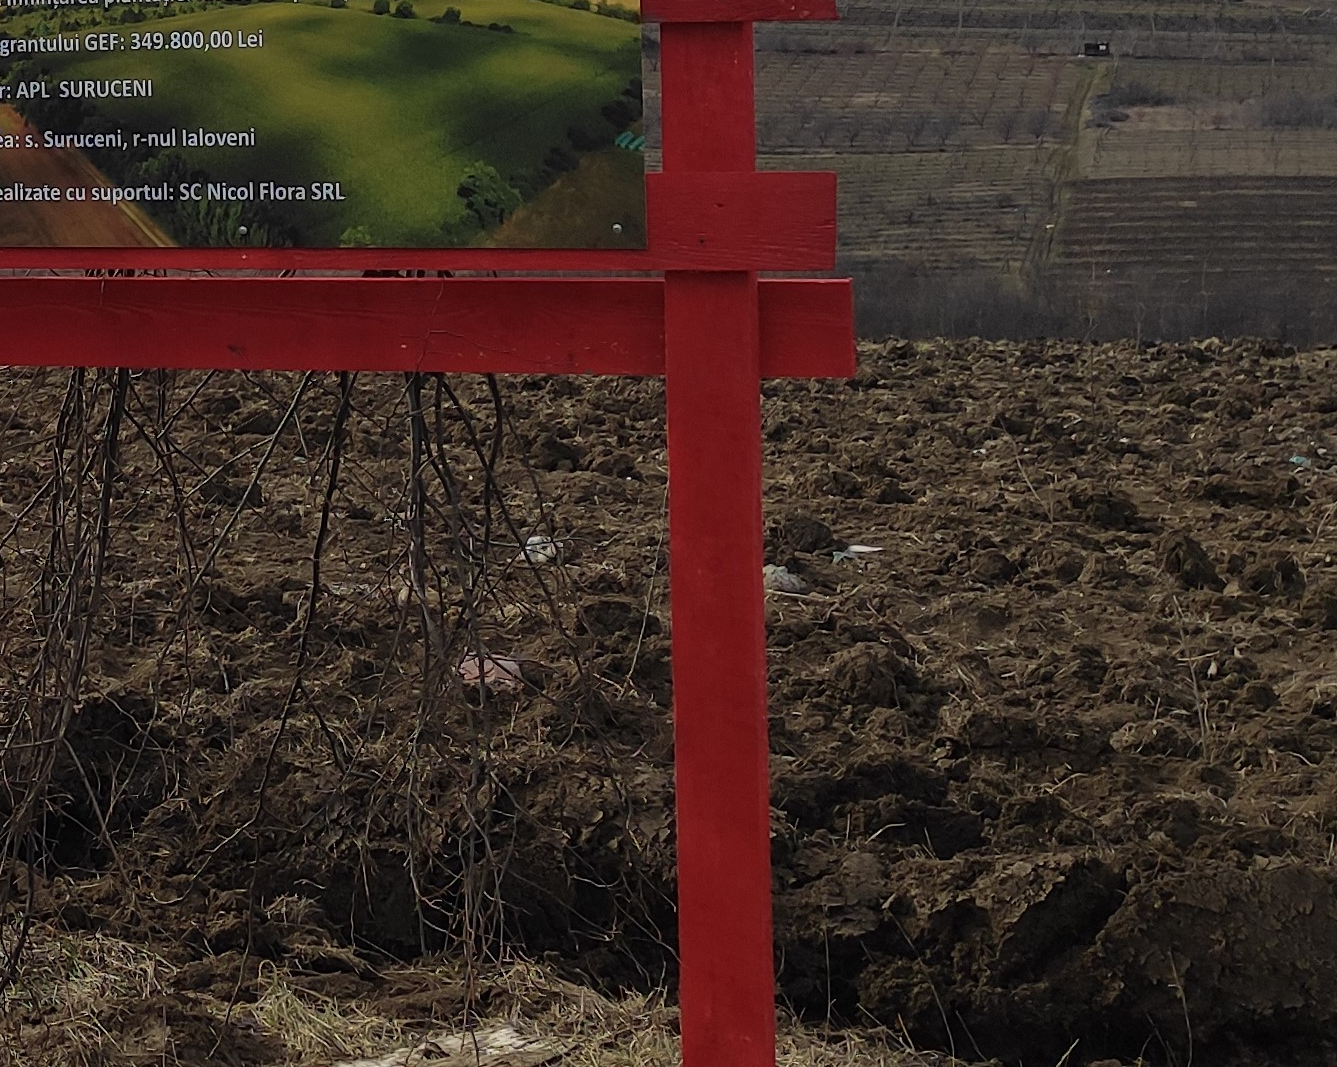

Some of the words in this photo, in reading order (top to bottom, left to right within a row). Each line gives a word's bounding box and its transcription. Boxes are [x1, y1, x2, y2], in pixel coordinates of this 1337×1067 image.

[0, 33, 80, 56] grantului
[84, 33, 125, 51] GEF:
[130, 31, 232, 52] 349.800,00
[237, 29, 263, 48] Lei
[16, 81, 50, 99] APL
[58, 79, 152, 97] SURUCENI
[25, 136, 39, 148] s.
[44, 129, 128, 150] Suruceni,
[133, 128, 176, 147] r-nul
[182, 127, 255, 146] Ialoveni
[66, 187, 86, 201] cu
[92, 182, 173, 204] suportul:
[179, 183, 202, 200] SC
[207, 182, 254, 200] Nicol
[259, 182, 305, 200] Flora
[311, 182, 345, 200] SRL
